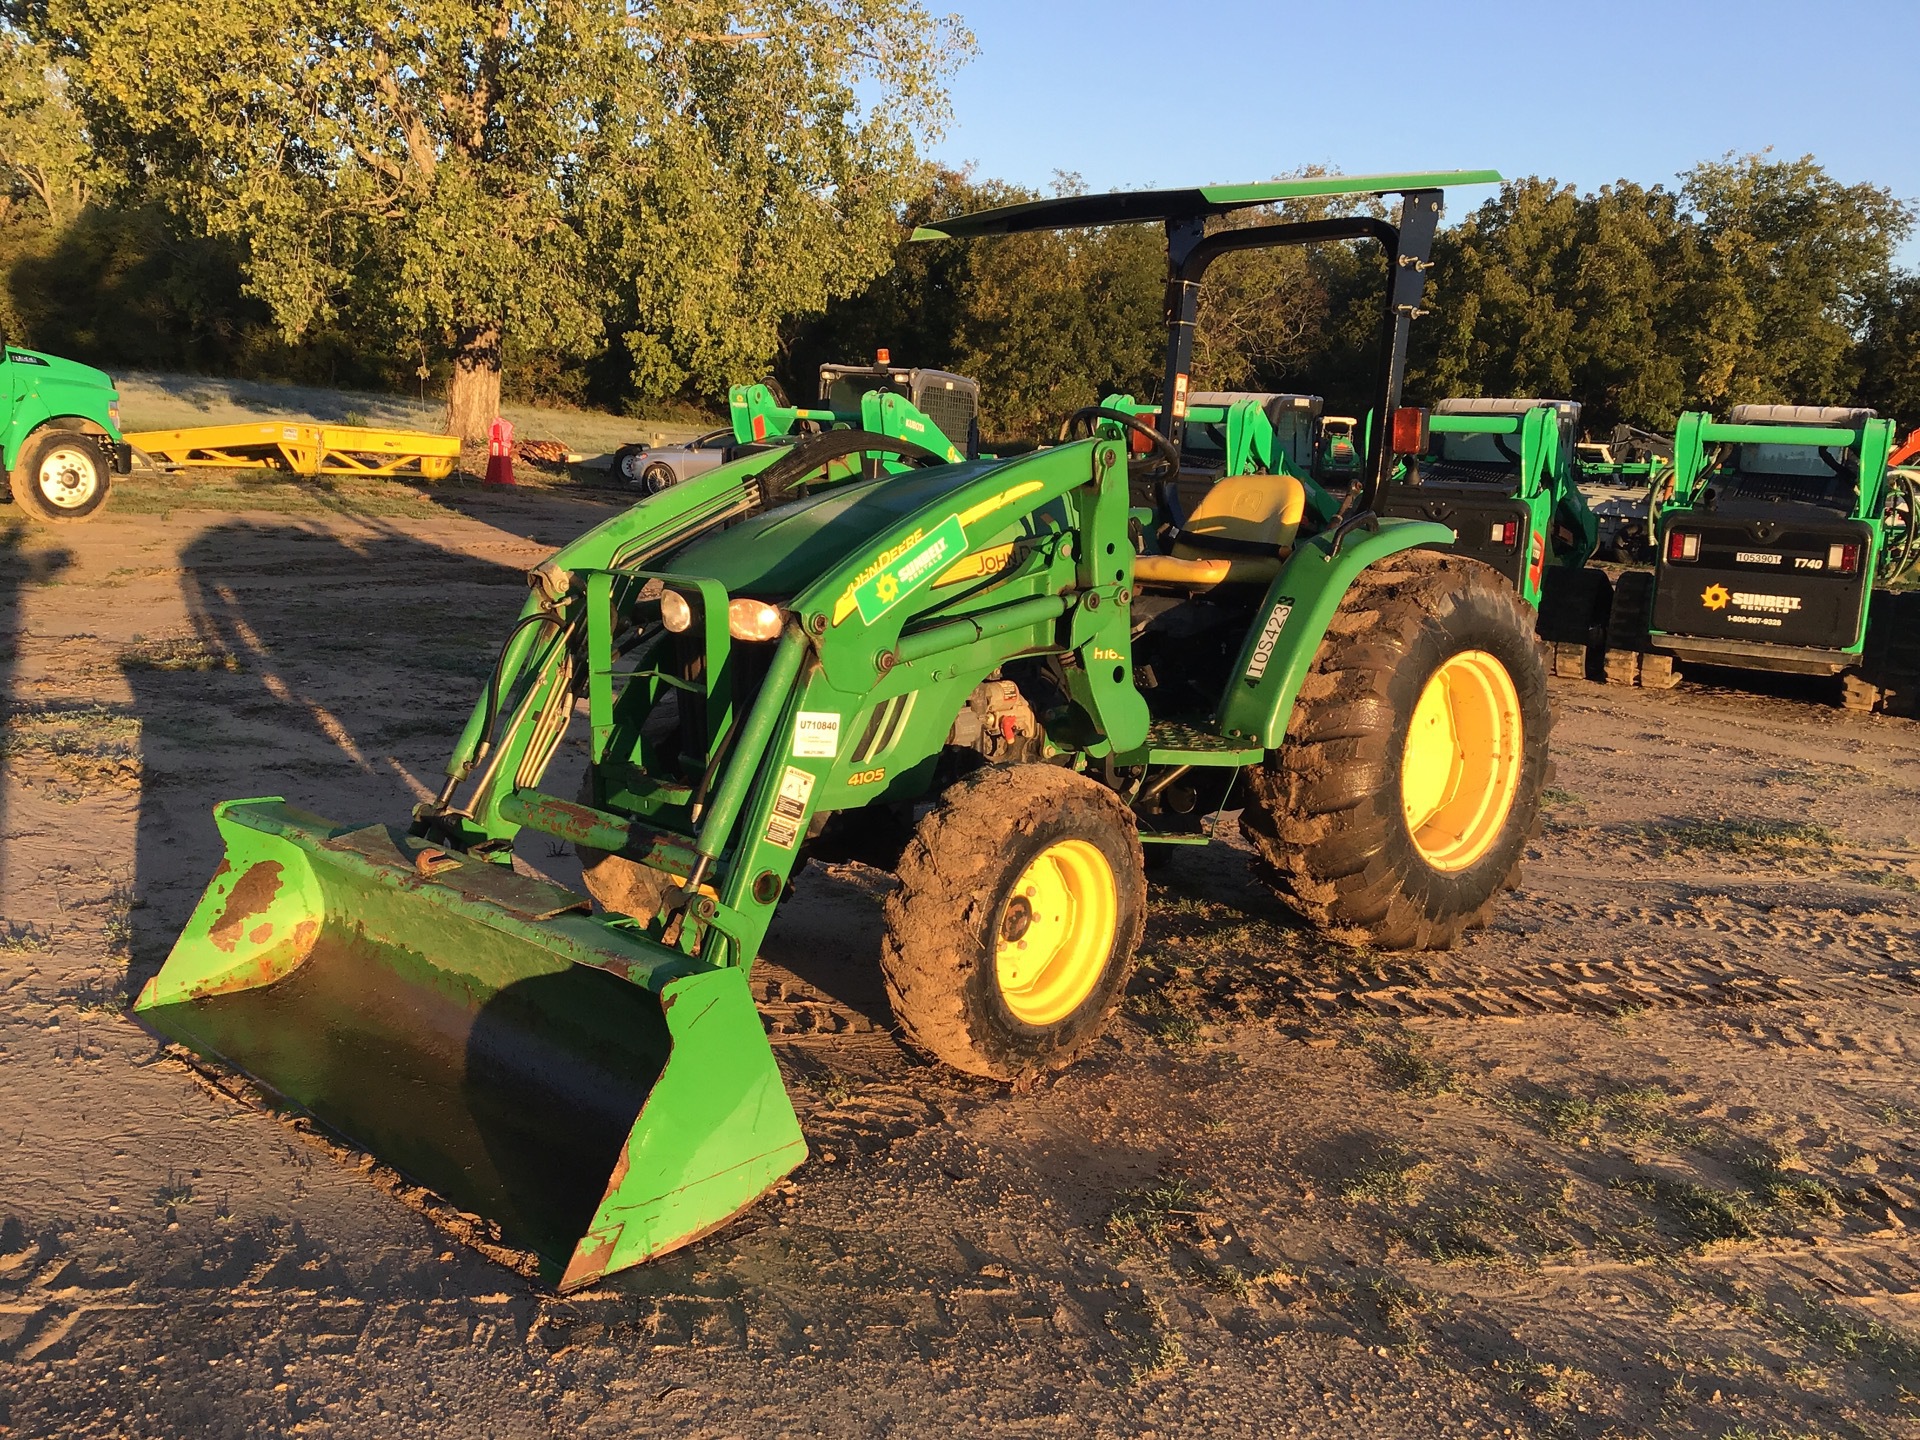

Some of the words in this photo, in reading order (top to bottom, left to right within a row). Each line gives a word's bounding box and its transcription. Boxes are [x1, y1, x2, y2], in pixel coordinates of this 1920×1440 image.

[878, 528, 923, 568] DEERE
[898, 537, 947, 582] SUNBELT
[977, 551, 1017, 574] JOHN
[1738, 553, 1780, 564] 1053901
[1794, 557, 1823, 570] T740
[1732, 592, 1801, 610] SUNBELT
[1740, 604, 1789, 614] RENTALS
[800, 720, 838, 731] U710840
[847, 767, 885, 786] 4105
